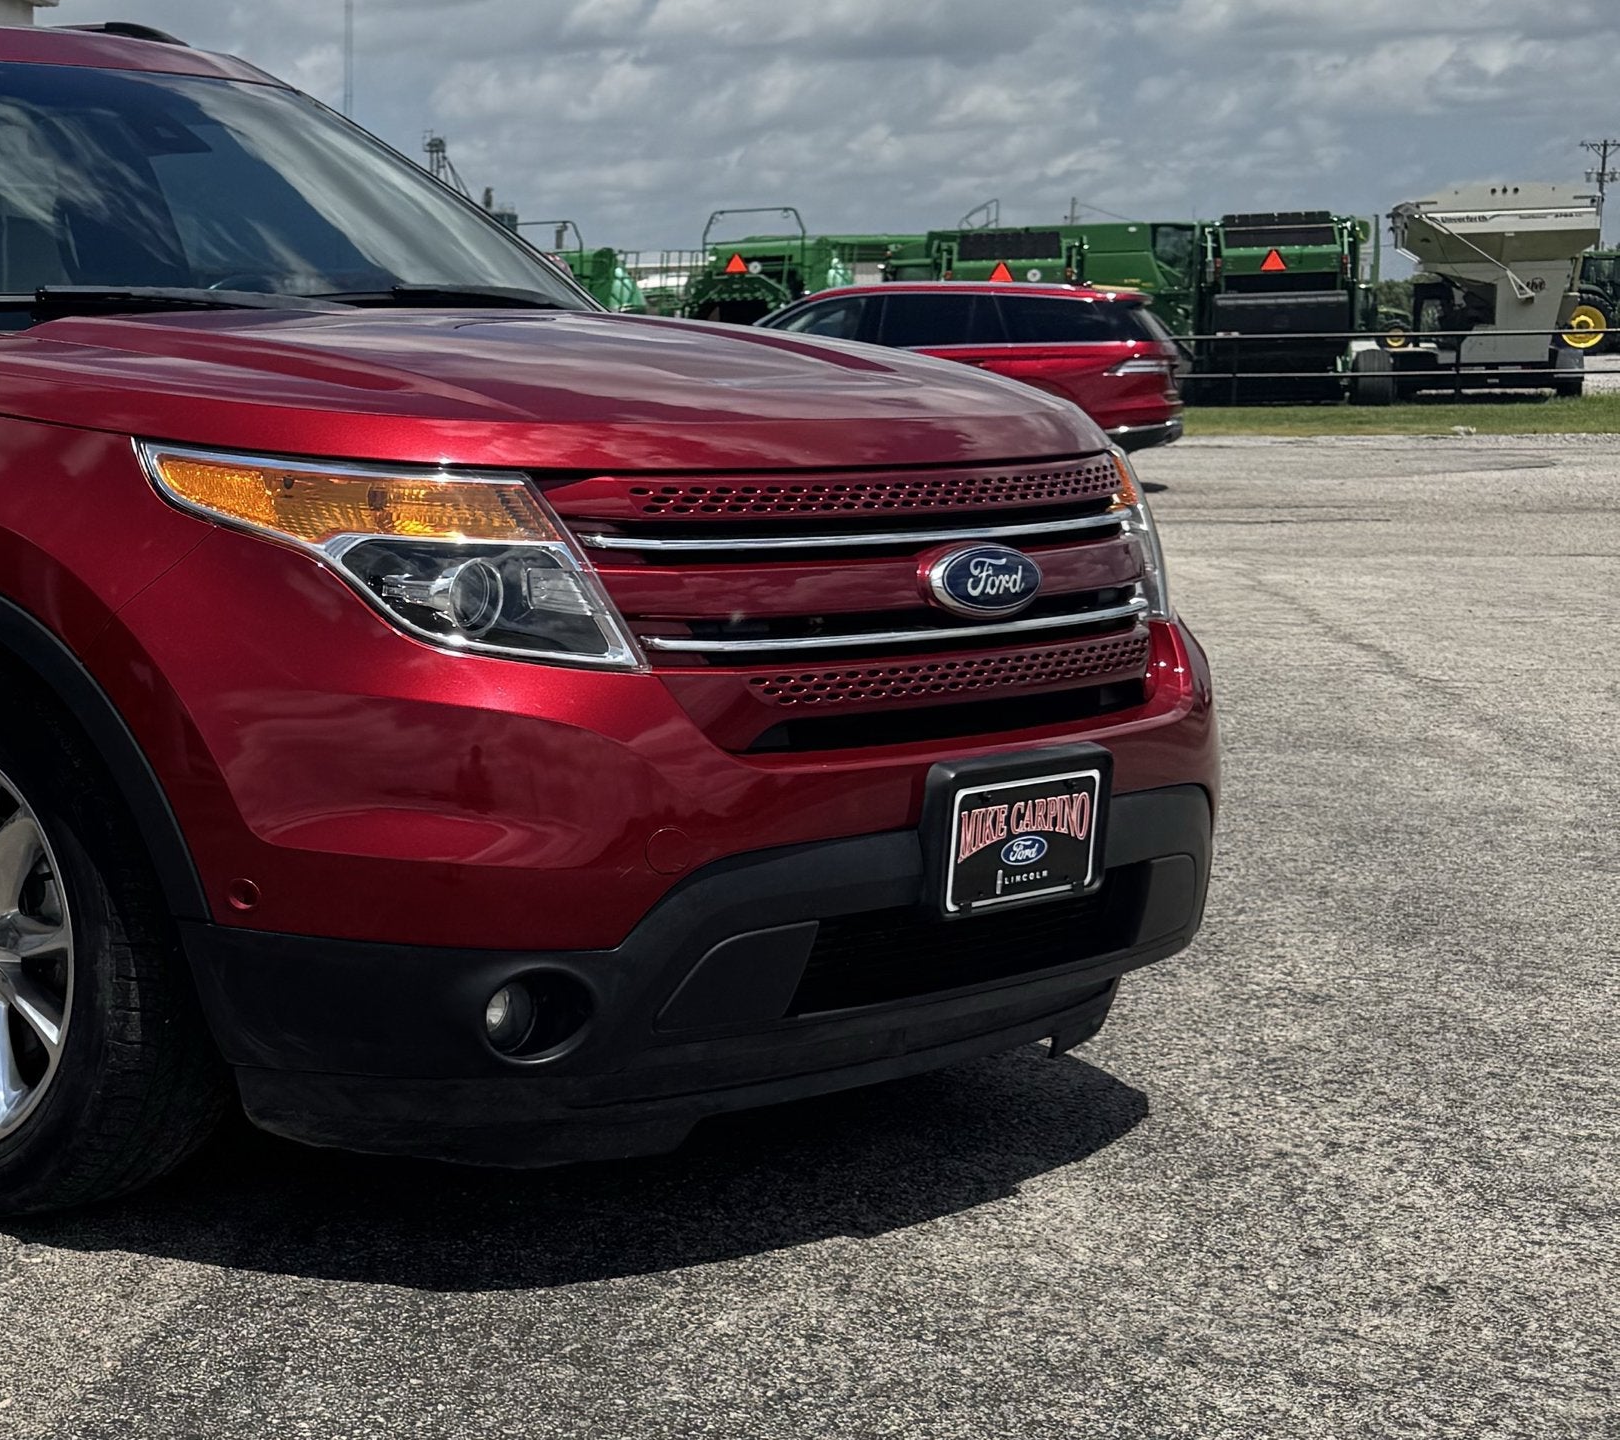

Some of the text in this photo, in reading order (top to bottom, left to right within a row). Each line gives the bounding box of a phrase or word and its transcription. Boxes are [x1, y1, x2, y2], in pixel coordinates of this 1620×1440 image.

[967, 558, 1025, 597] Ford
[957, 791, 1090, 864] MIKE CARPINO
[1009, 840, 1039, 862] Ford
[1004, 870, 1048, 885] LINCOLN
